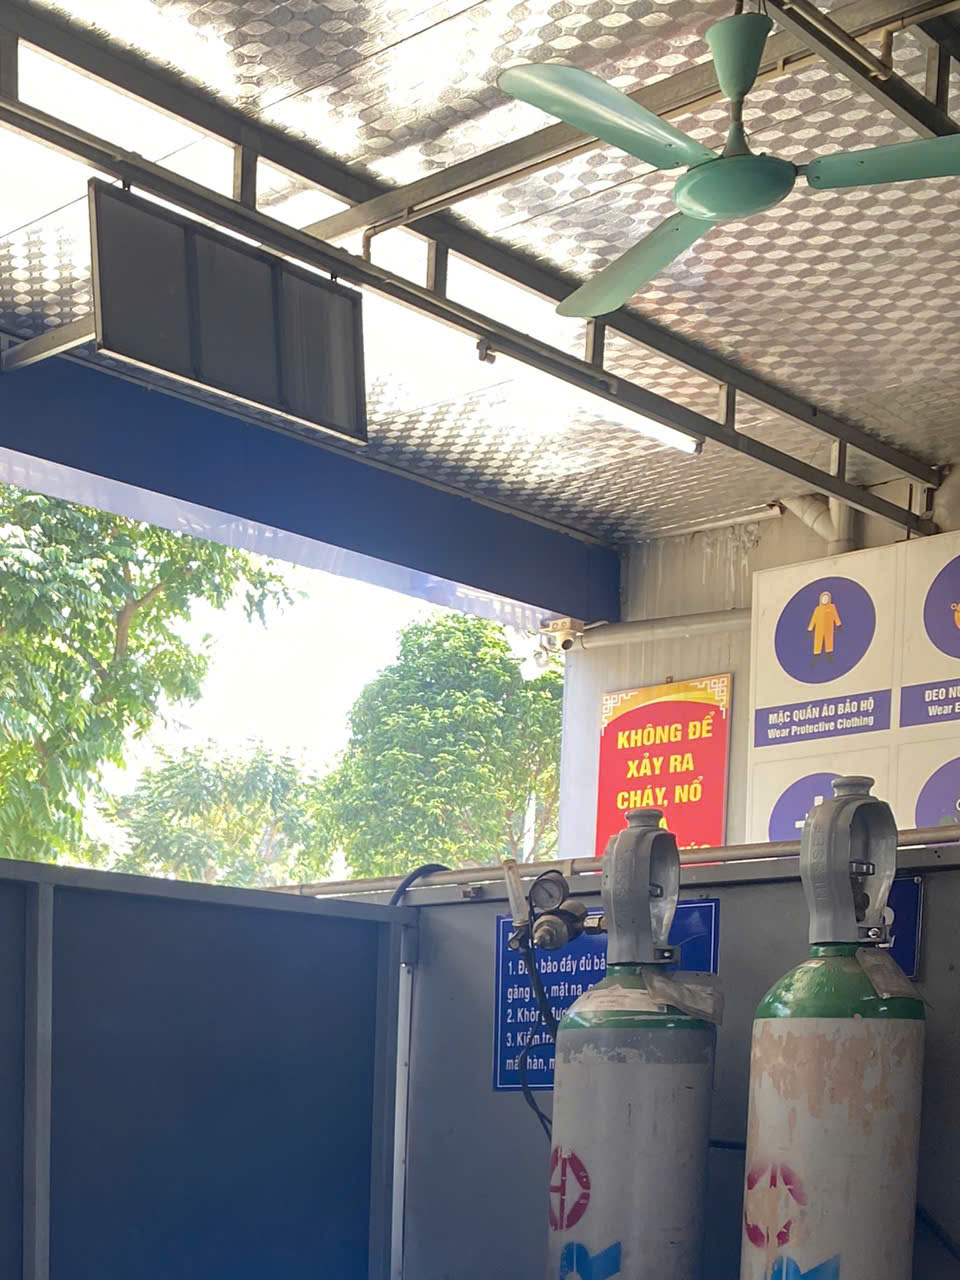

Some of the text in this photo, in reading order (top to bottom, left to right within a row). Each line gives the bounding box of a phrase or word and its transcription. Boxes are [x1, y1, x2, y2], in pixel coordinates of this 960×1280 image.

[837, 699, 858, 715] BẢO
[928, 704, 954, 717] Wear
[617, 711, 716, 749] KHÔNG ĐỂ
[767, 716, 875, 739] Wear Protective Clothing
[626, 752, 695, 778] XẢY RA
[616, 775, 704, 810] CHÁY, NỔ
[508, 961, 516, 976] 1.
[540, 956, 559, 974] bảo
[594, 952, 608, 971] bả
[506, 1009, 515, 1023] 2.
[506, 1032, 515, 1047] 3.
